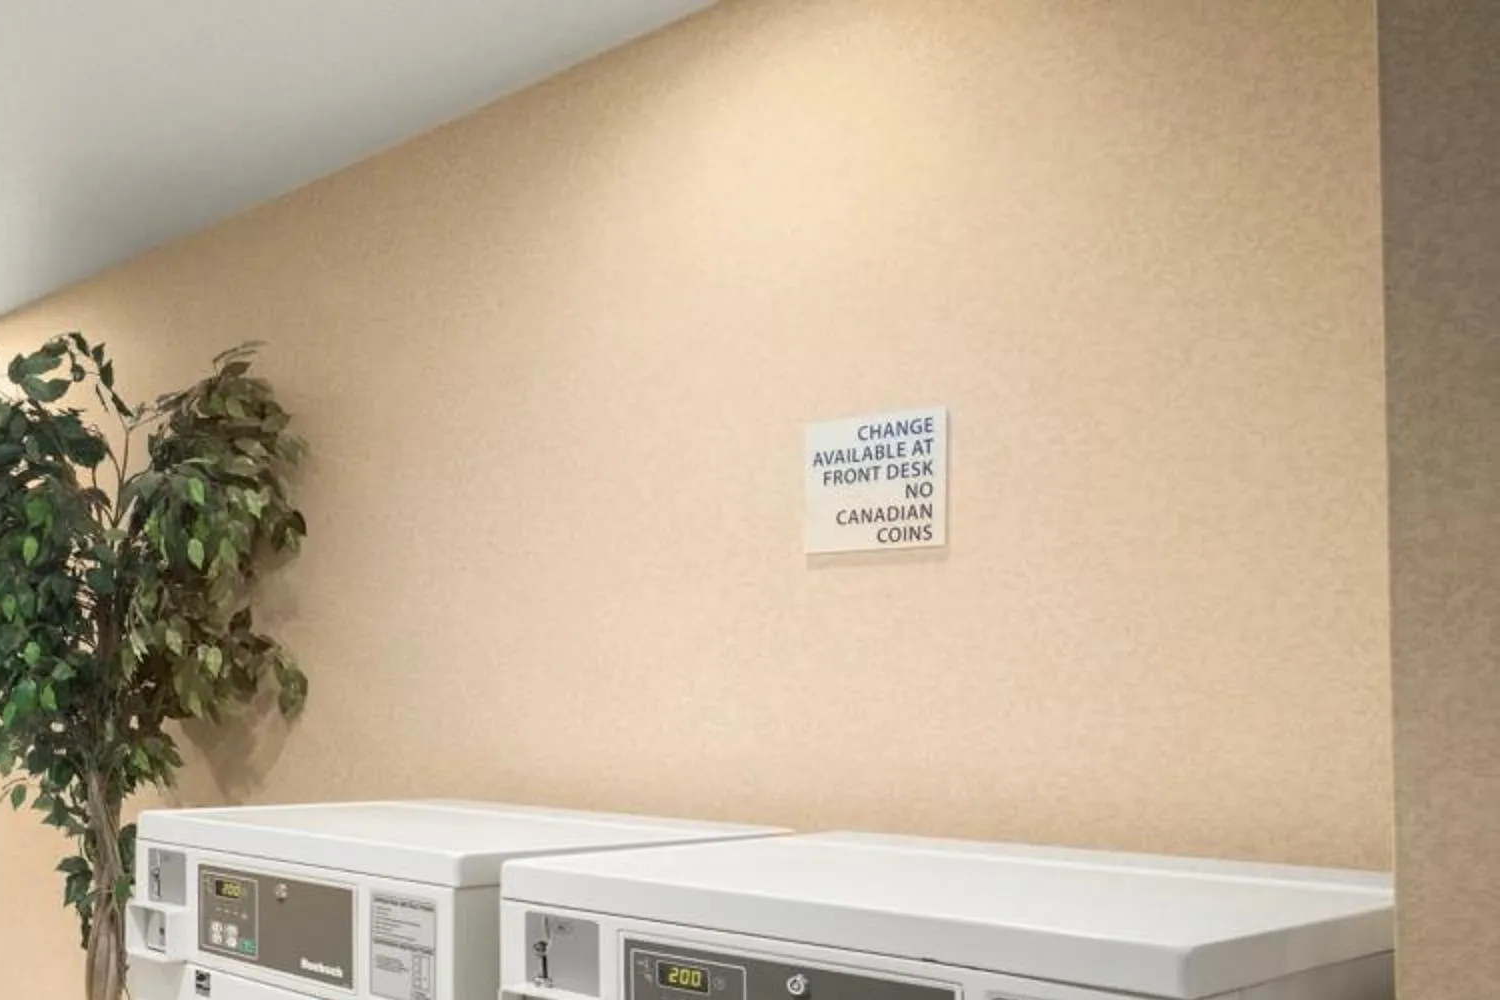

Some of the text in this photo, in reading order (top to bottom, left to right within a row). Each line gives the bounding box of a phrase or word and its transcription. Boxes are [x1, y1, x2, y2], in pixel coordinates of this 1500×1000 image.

[857, 417, 934, 441] CHANGE
[812, 438, 934, 468] AVAILABLE AT
[822, 460, 934, 487] FRONT DESK
[905, 481, 933, 499] NO
[835, 503, 933, 526] CANADIAN
[876, 524, 933, 544] COINS
[667, 966, 702, 988] 200
